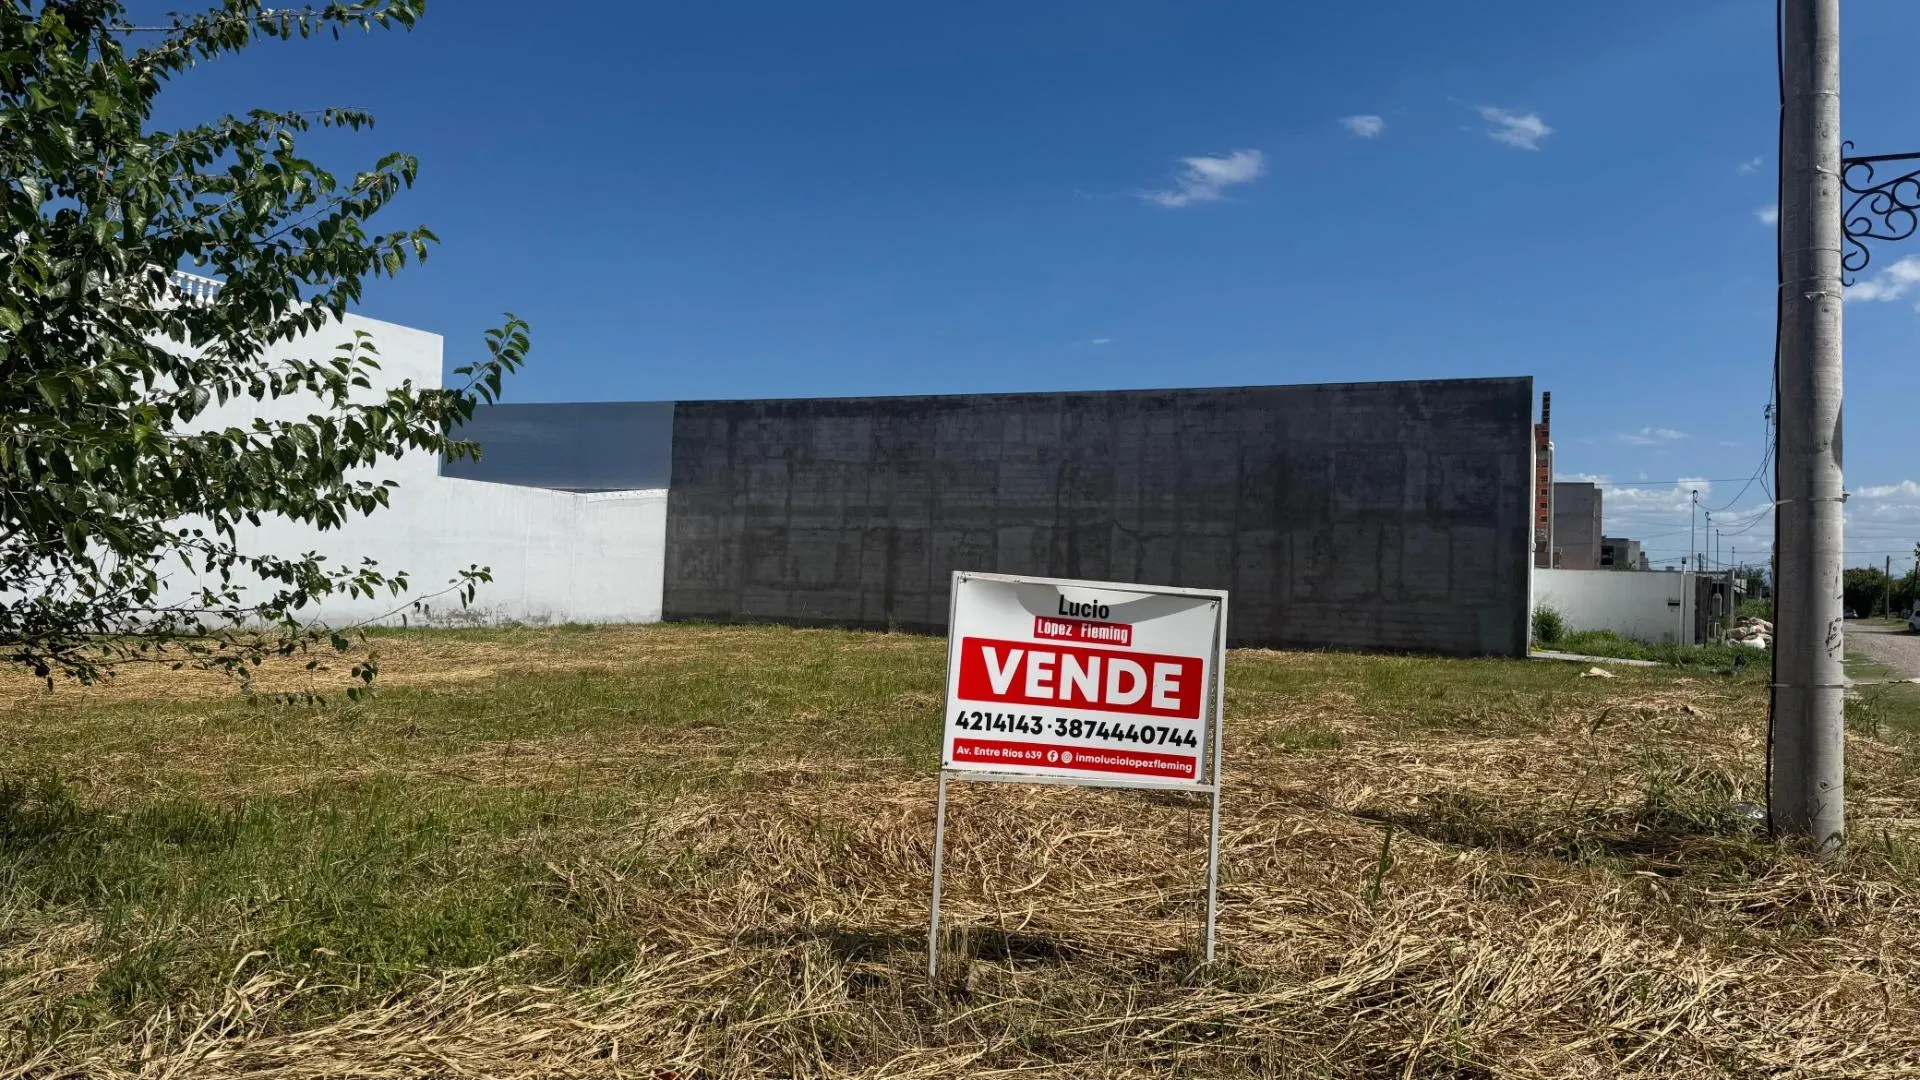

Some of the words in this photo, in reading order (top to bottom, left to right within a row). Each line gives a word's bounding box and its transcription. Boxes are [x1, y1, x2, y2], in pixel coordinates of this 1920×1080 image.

[1058, 594, 1110, 620] Lucio
[1080, 622, 1129, 644] Fleming
[981, 645, 1184, 711] VENDE
[956, 745, 972, 755] Av.
[974, 746, 1001, 757] Entre
[1002, 748, 1024, 758] Ríos
[1025, 751, 1043, 760] 639
[1075, 752, 1193, 774] inmoluciolopezfleming
